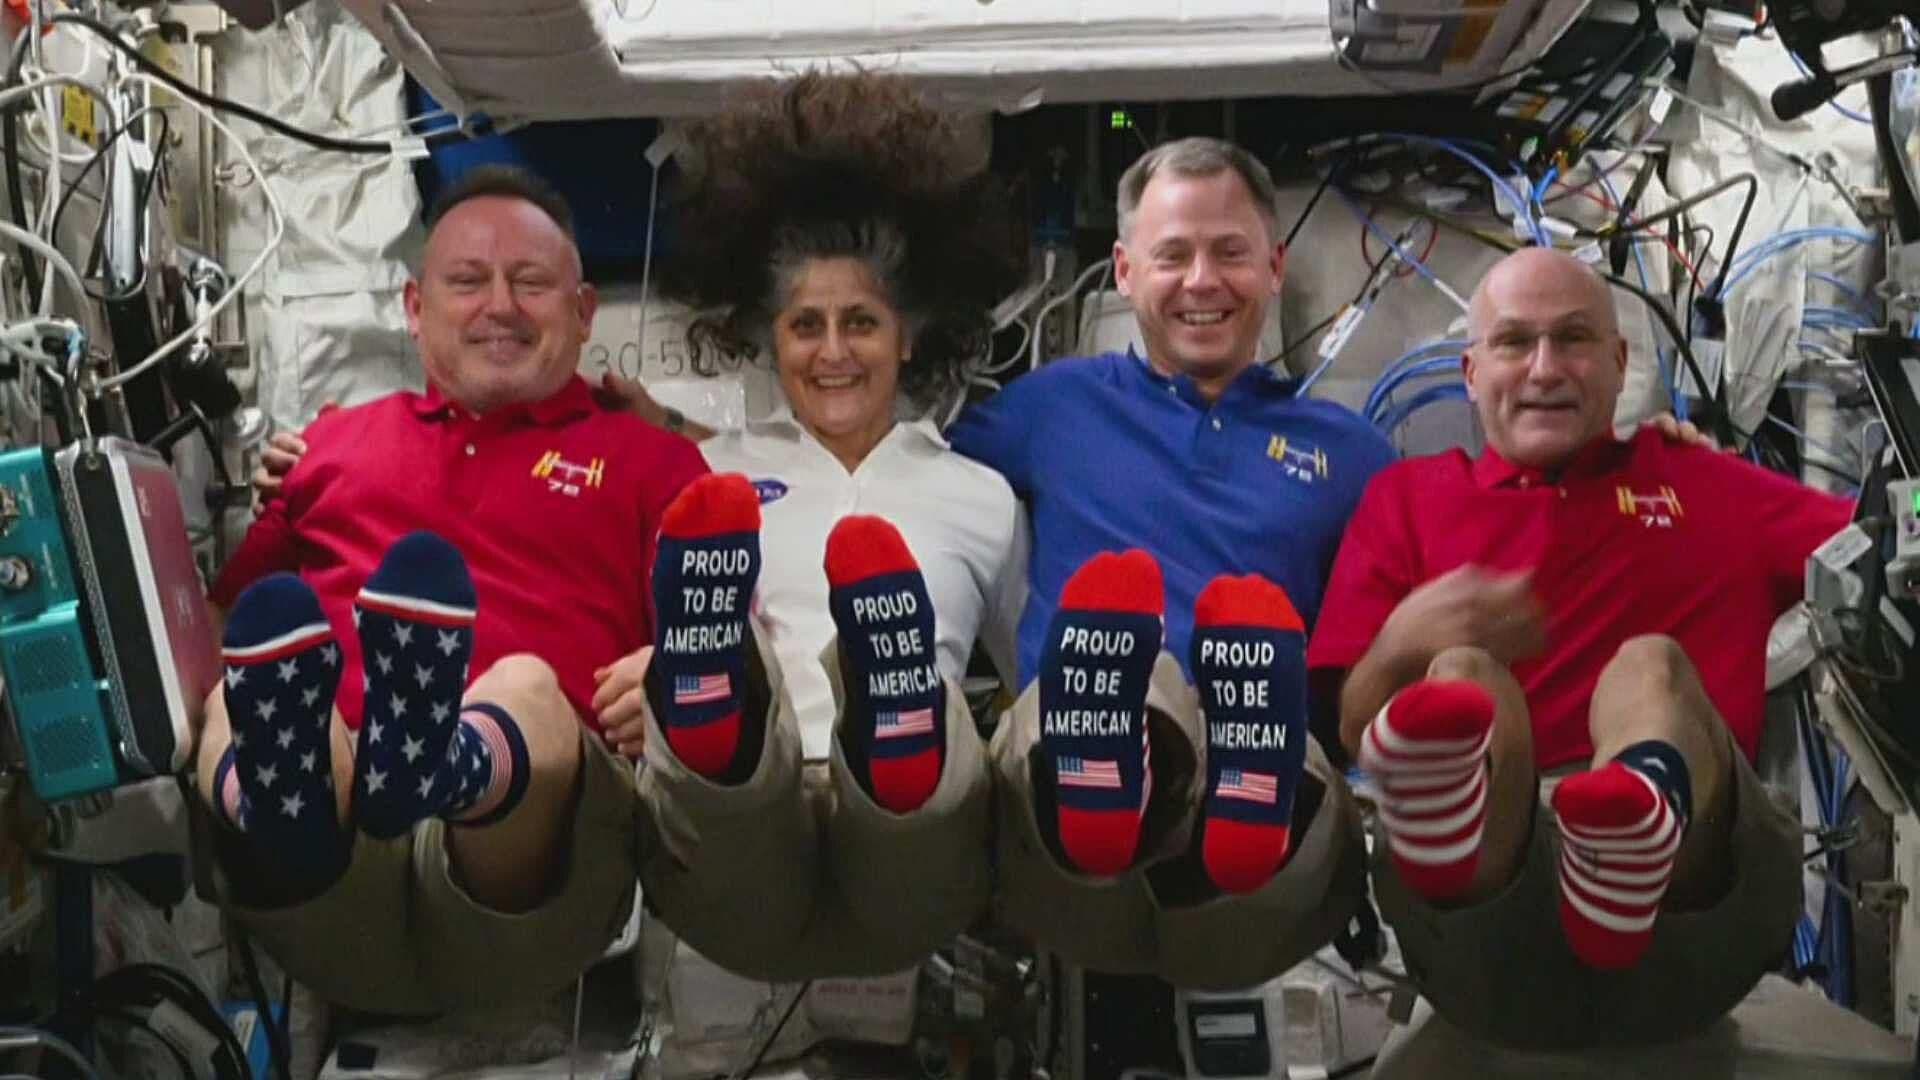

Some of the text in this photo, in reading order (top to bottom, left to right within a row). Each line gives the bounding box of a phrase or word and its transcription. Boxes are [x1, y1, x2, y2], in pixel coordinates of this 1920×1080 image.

[682, 550, 750, 576] PROUD
[683, 587, 738, 614] TO BE
[853, 591, 917, 624] PROUD
[663, 622, 743, 654] AMERICAN
[869, 628, 924, 659] TO BE
[1060, 626, 1135, 656] PROUD
[1201, 640, 1274, 667] PROUD
[1062, 666, 1122, 695] TO BE
[1212, 680, 1268, 707] TO BE
[1044, 710, 1131, 736] AMERICAN
